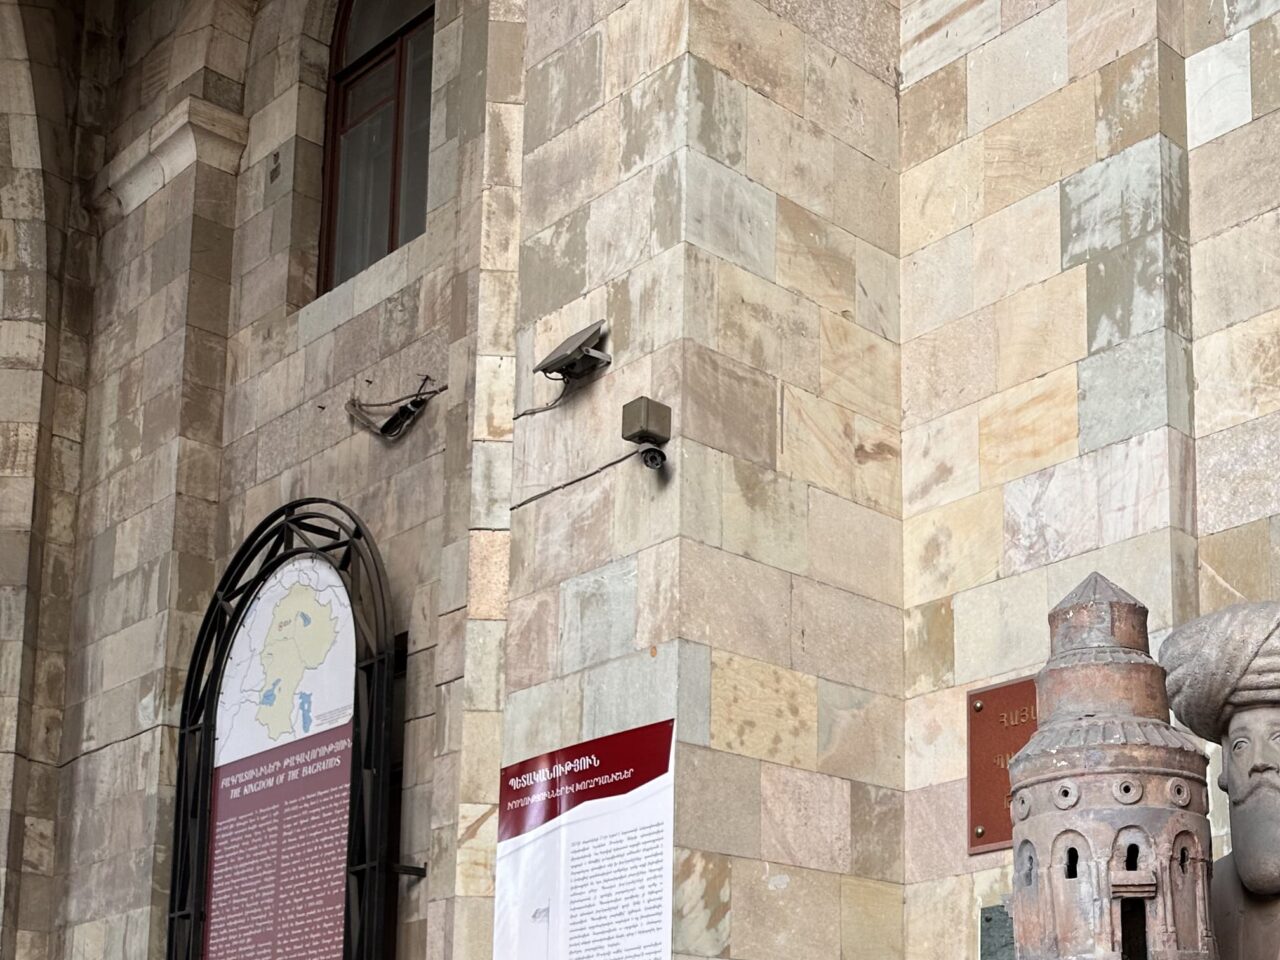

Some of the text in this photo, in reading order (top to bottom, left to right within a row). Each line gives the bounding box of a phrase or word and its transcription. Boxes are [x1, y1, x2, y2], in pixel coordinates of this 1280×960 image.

[230, 786, 242, 799] THE
[243, 776, 275, 796] KINGDOM
[276, 773, 285, 785] OF
[287, 768, 300, 782] THE
[508, 754, 600, 790] ՊԵՏԱԿԱՆՈՒԹՅՈՒՆ
